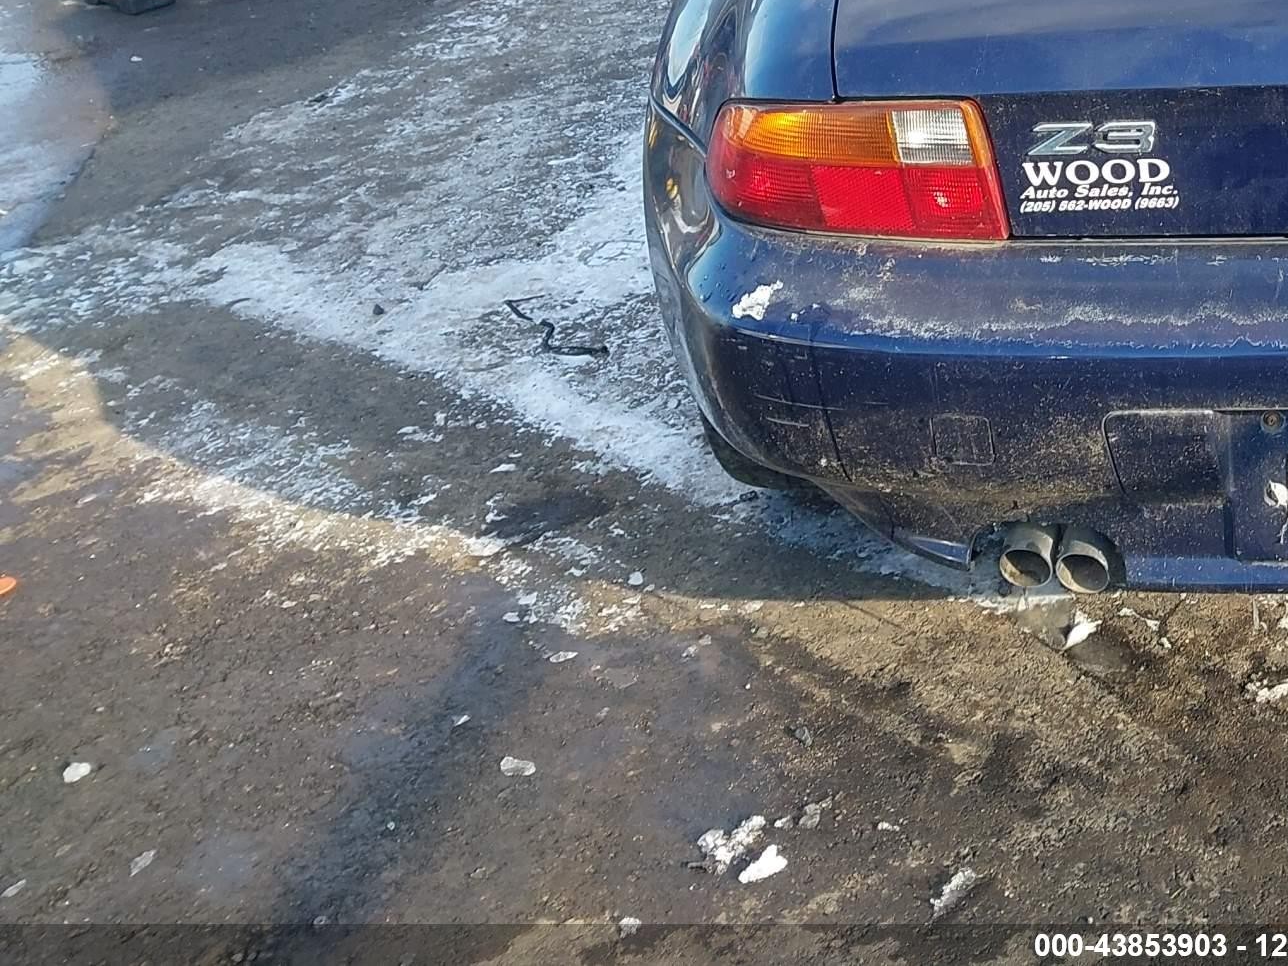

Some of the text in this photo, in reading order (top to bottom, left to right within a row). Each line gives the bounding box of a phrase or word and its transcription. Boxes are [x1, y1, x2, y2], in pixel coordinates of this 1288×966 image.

[1027, 121, 1156, 155] Z3
[1022, 159, 1170, 186] WOOD
[1020, 183, 1179, 199] Auto Sales, Inc.
[1020, 200, 1056, 214] (205)
[1134, 196, 1180, 210] (9663)
